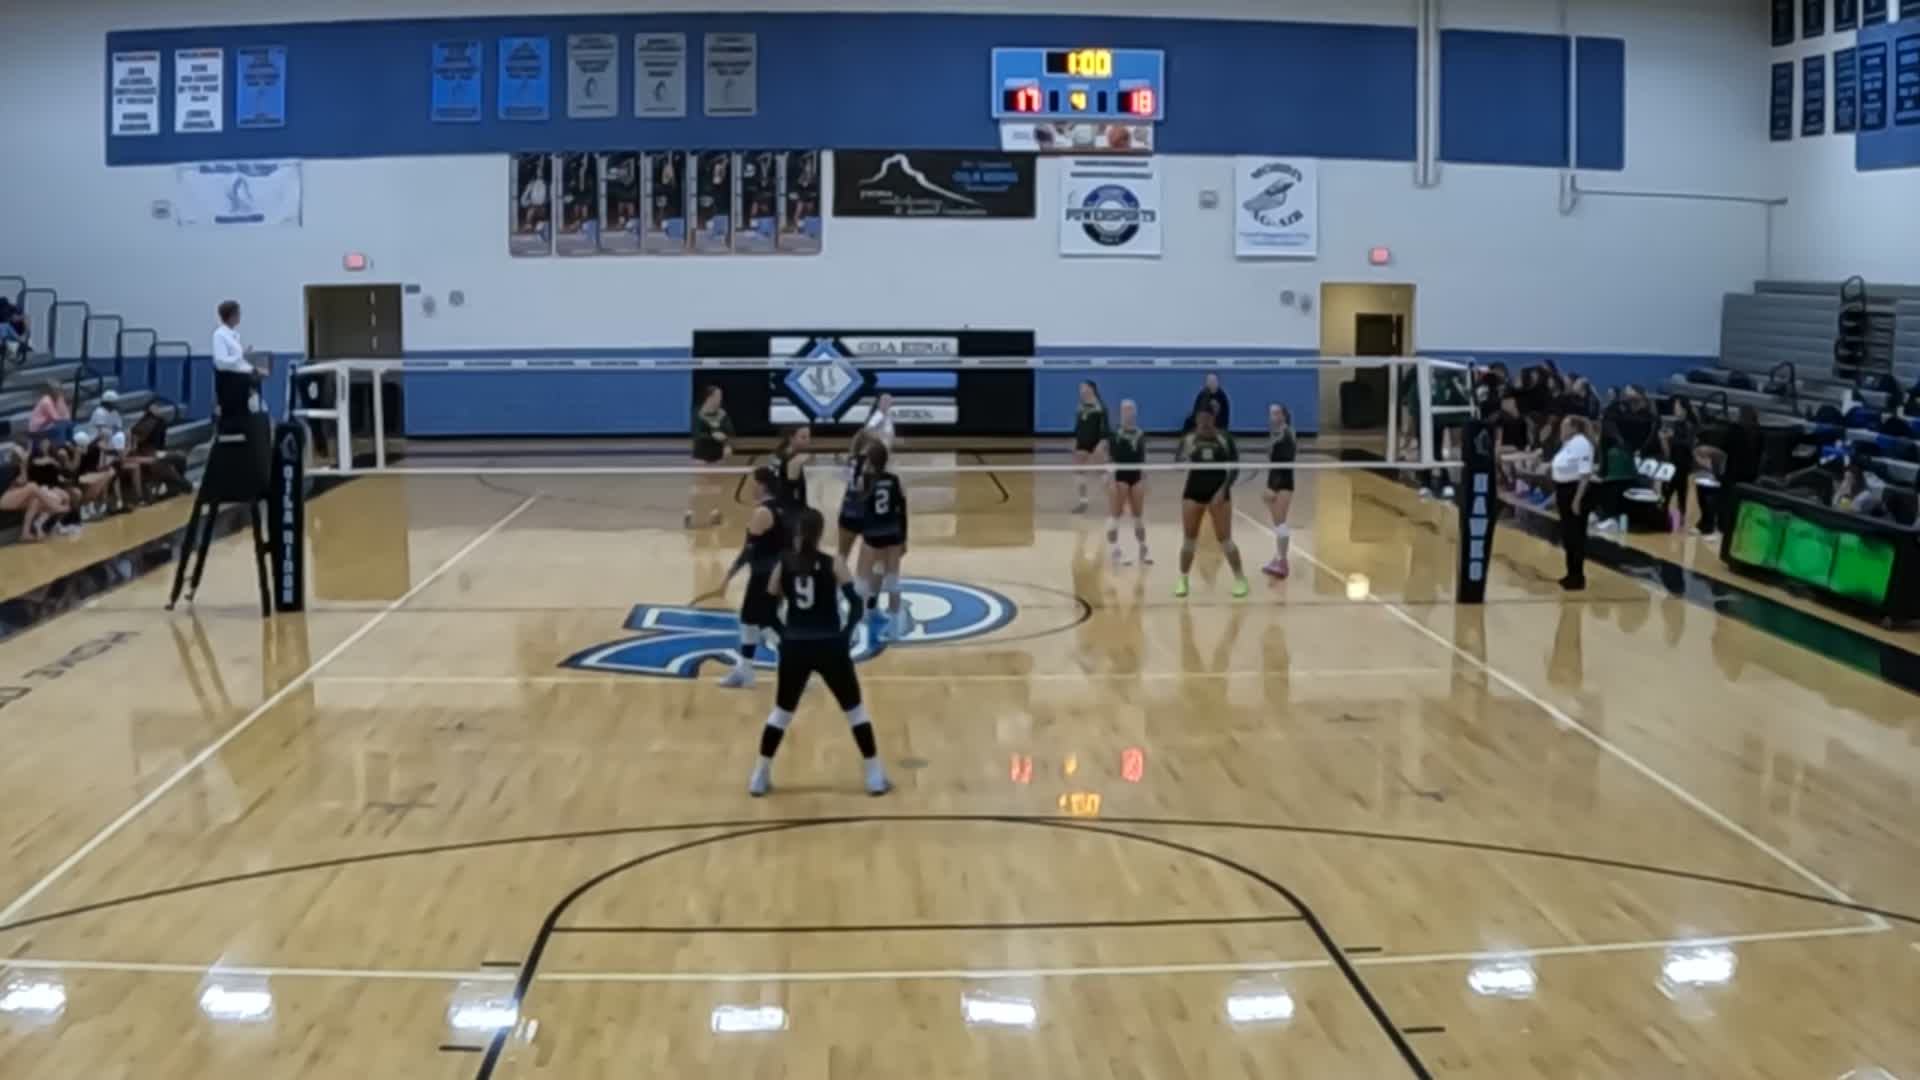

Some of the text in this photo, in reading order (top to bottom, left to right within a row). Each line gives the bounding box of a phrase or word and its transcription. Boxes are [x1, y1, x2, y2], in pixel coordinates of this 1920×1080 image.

[1068, 50, 1111, 76] 1:00
[1017, 88, 1040, 112] 17
[1071, 92, 1086, 110] 4
[1131, 89, 1152, 113] 18
[874, 488, 890, 515] 2
[794, 575, 815, 610] 9
